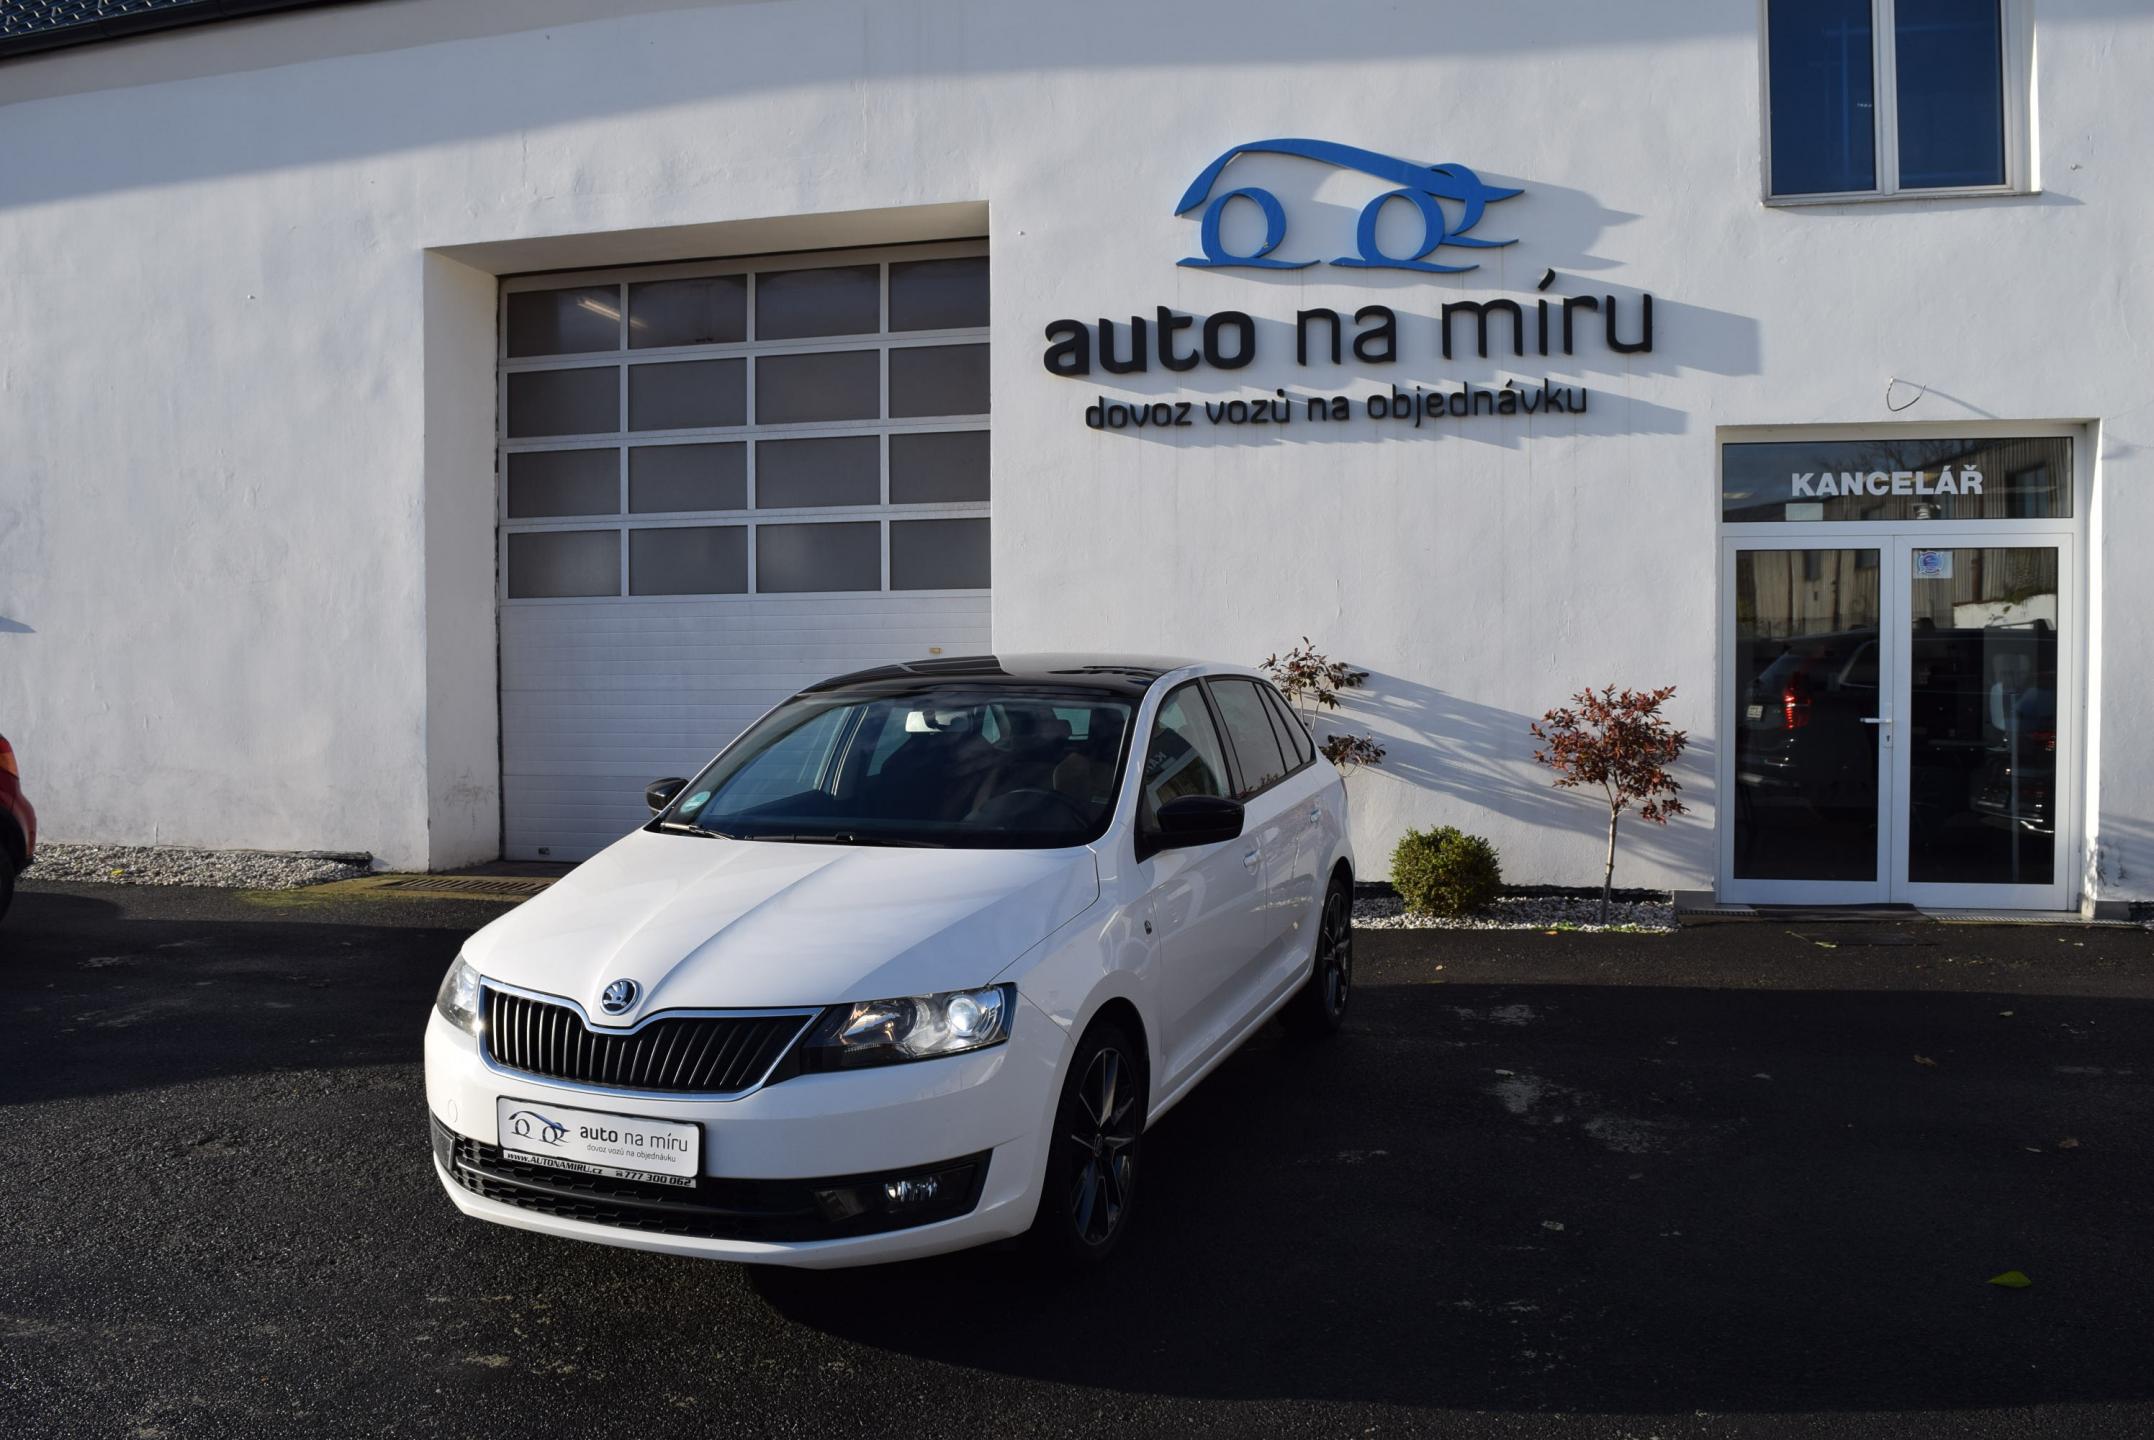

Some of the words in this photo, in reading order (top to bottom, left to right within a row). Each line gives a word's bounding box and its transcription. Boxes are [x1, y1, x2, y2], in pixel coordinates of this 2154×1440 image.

[1043, 305, 1256, 375] auto
[1297, 304, 1397, 367] na
[1442, 268, 1653, 360] míru
[1085, 395, 1192, 429] dovoz
[1205, 388, 1290, 425] vozů
[1307, 396, 1350, 421] na
[1367, 378, 1587, 428] objednávku
[1791, 464, 1984, 496] KANCELÁŘ
[580, 1126, 618, 1143] auto
[624, 1132, 644, 1147] na
[650, 1132, 688, 1152] míru
[586, 1144, 607, 1153] dovoz
[636, 1151, 677, 1163] objednávku
[624, 1171, 644, 1180] 777
[645, 1174, 667, 1183] 300
